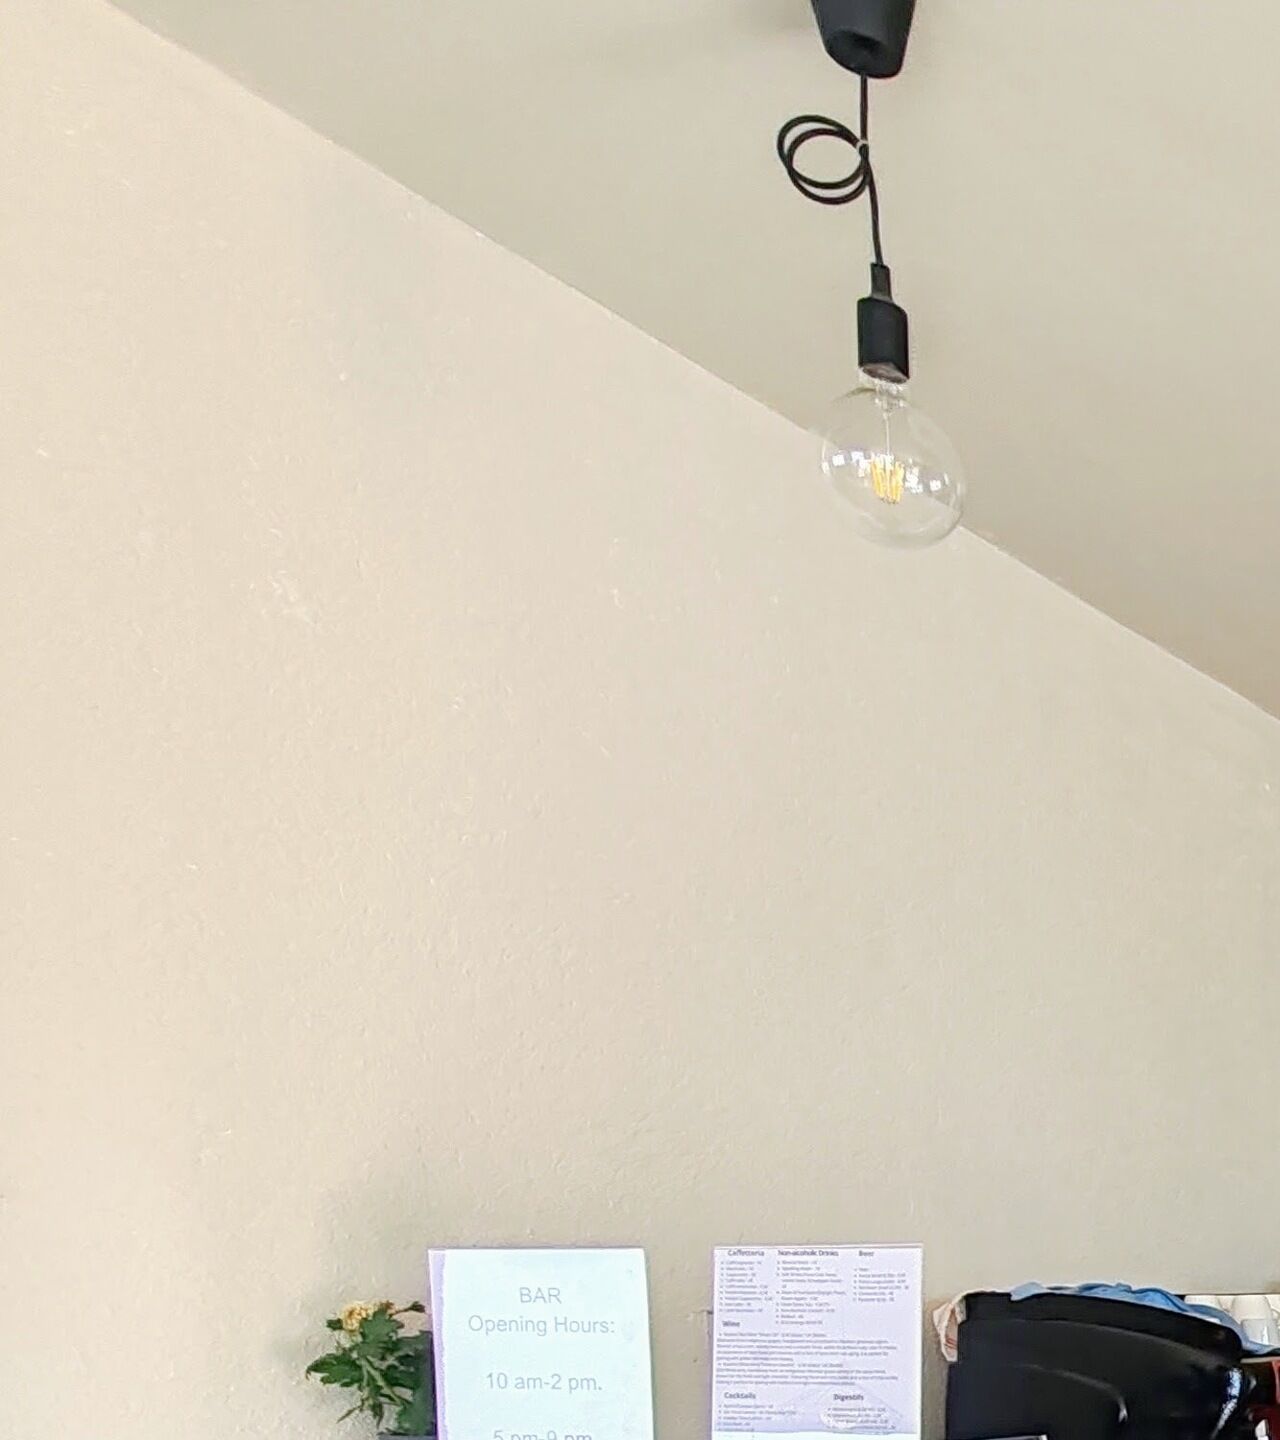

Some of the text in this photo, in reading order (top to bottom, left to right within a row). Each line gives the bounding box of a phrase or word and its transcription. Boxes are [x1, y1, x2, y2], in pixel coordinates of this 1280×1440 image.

[519, 1286, 562, 1304] BAR
[468, 1315, 615, 1337] Opening Hours:
[722, 1320, 740, 1328] Wine
[486, 1372, 602, 1394] 10 am-2 pm.
[724, 1391, 756, 1399] Cocktails
